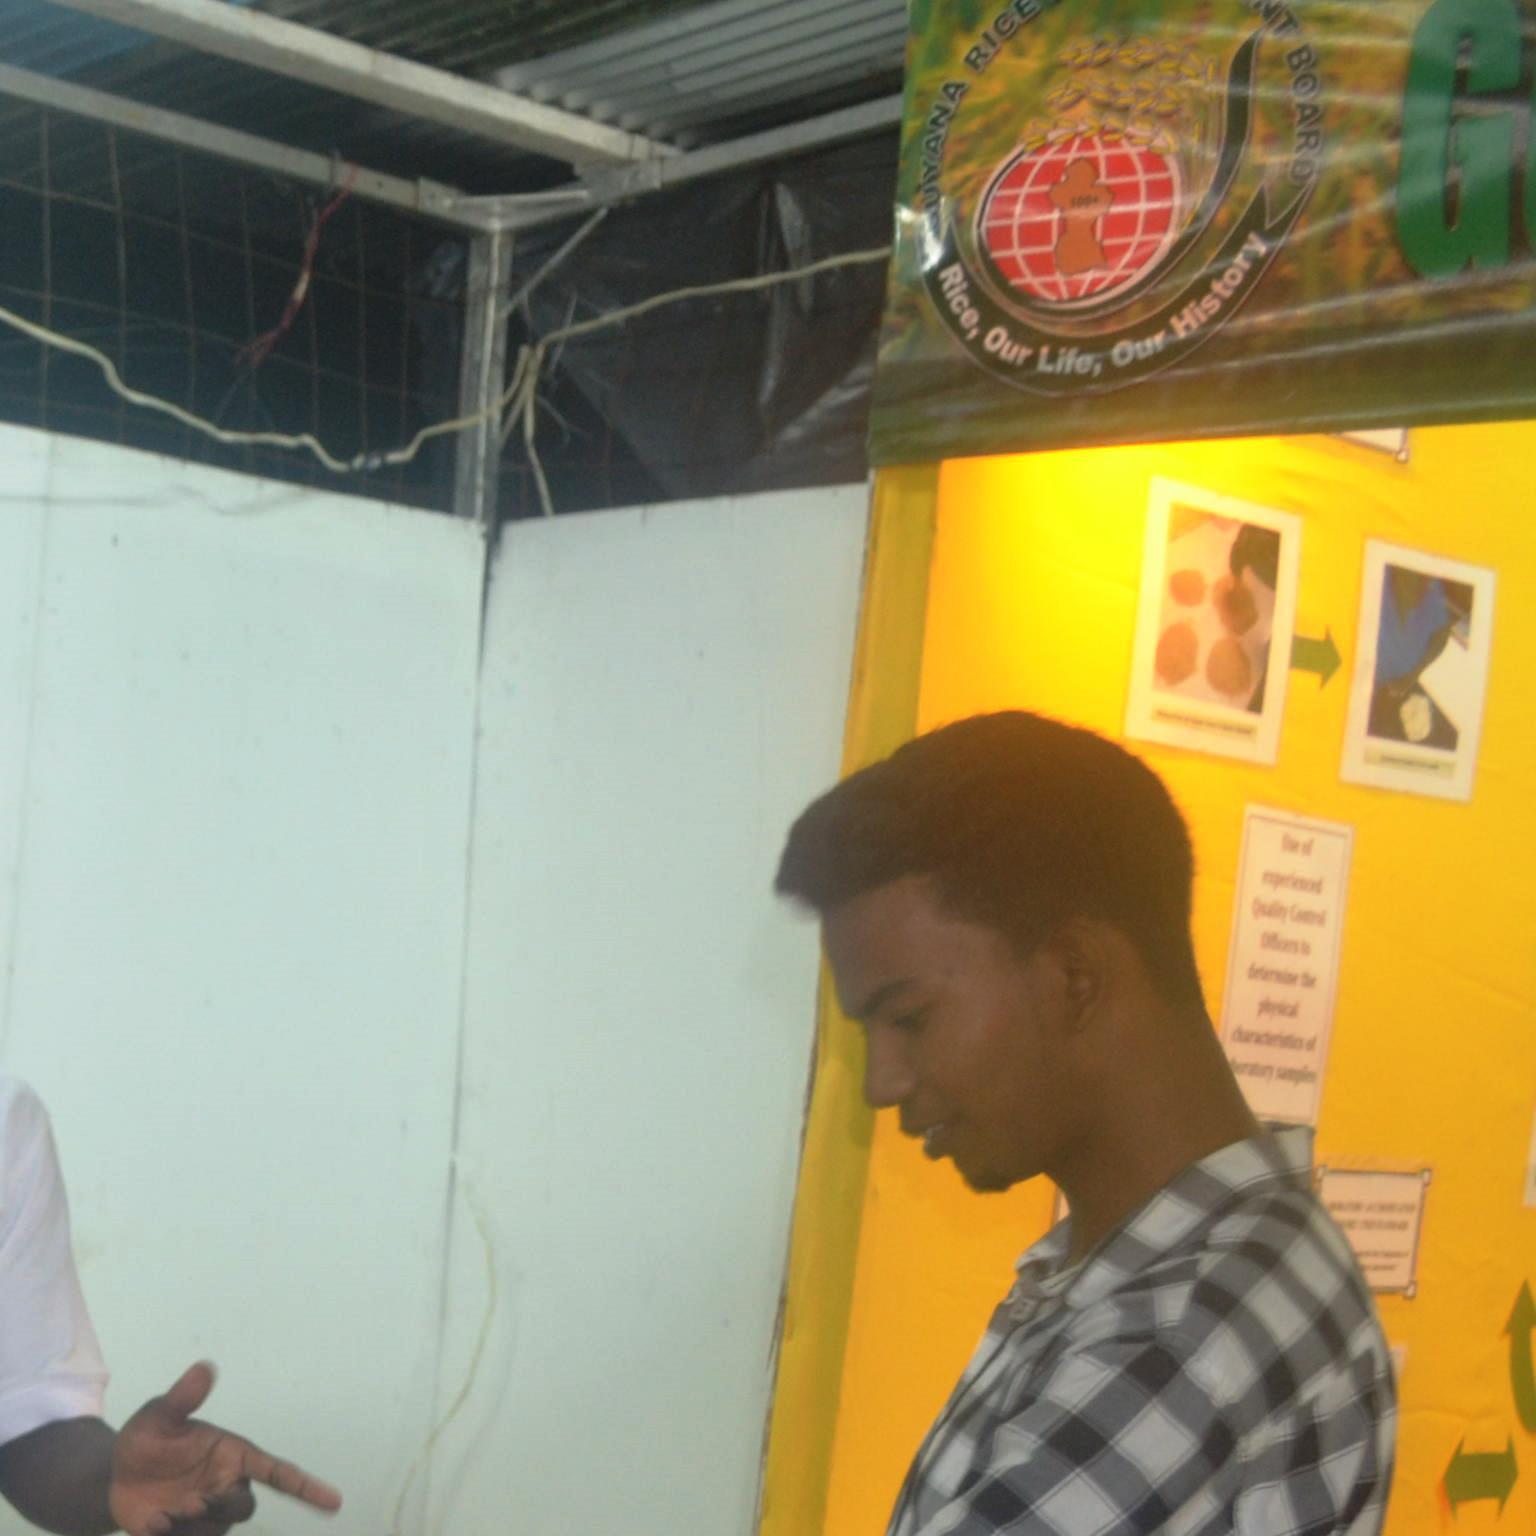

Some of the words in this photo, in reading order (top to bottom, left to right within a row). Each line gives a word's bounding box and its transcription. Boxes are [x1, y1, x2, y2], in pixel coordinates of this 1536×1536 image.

[1285, 44, 1330, 187] BOARD
[983, 323, 1034, 368] Our
[1112, 332, 1167, 368] Our
[1172, 232, 1270, 341] History
